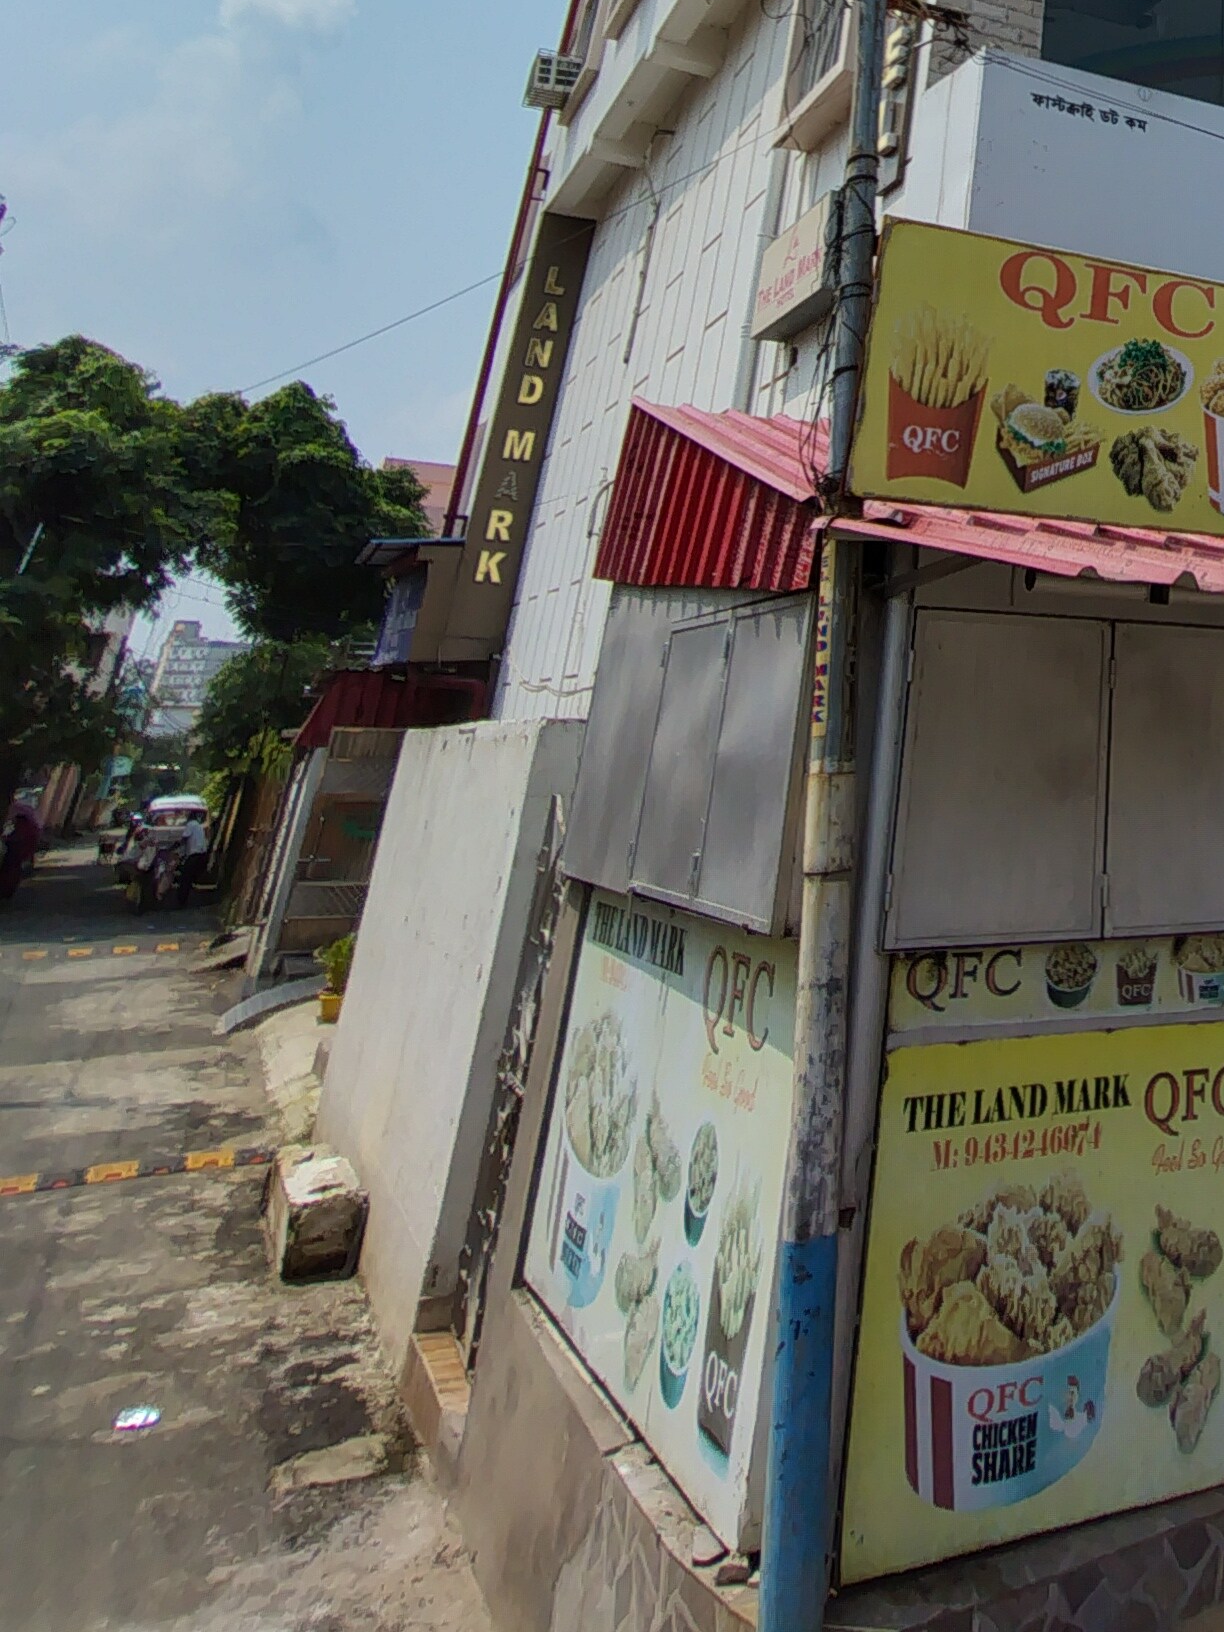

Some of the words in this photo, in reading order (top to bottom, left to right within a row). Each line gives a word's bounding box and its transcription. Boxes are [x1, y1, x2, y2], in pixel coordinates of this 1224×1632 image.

[1124, 116, 1147, 133] কম
[999, 250, 1216, 340] QFC
[517, 266, 566, 405] LAND
[902, 424, 961, 454] QFC
[1030, 454, 1077, 484] SIGNATURE
[1076, 449, 1094, 471] BOX
[593, 901, 618, 948] THE
[703, 944, 776, 1054] QFC
[906, 948, 1022, 1012] QFC
[1121, 984, 1150, 999] QFC
[903, 1090, 966, 1133] THE
[971, 1083, 1048, 1125] LAND
[1053, 1073, 1132, 1117] MARK
[1188, 1139, 1206, 1169] So
[706, 1350, 737, 1418] QFC
[967, 1376, 1044, 1422] QFC
[972, 1412, 1038, 1451] CHICKEN
[971, 1440, 1037, 1486] SHARE
